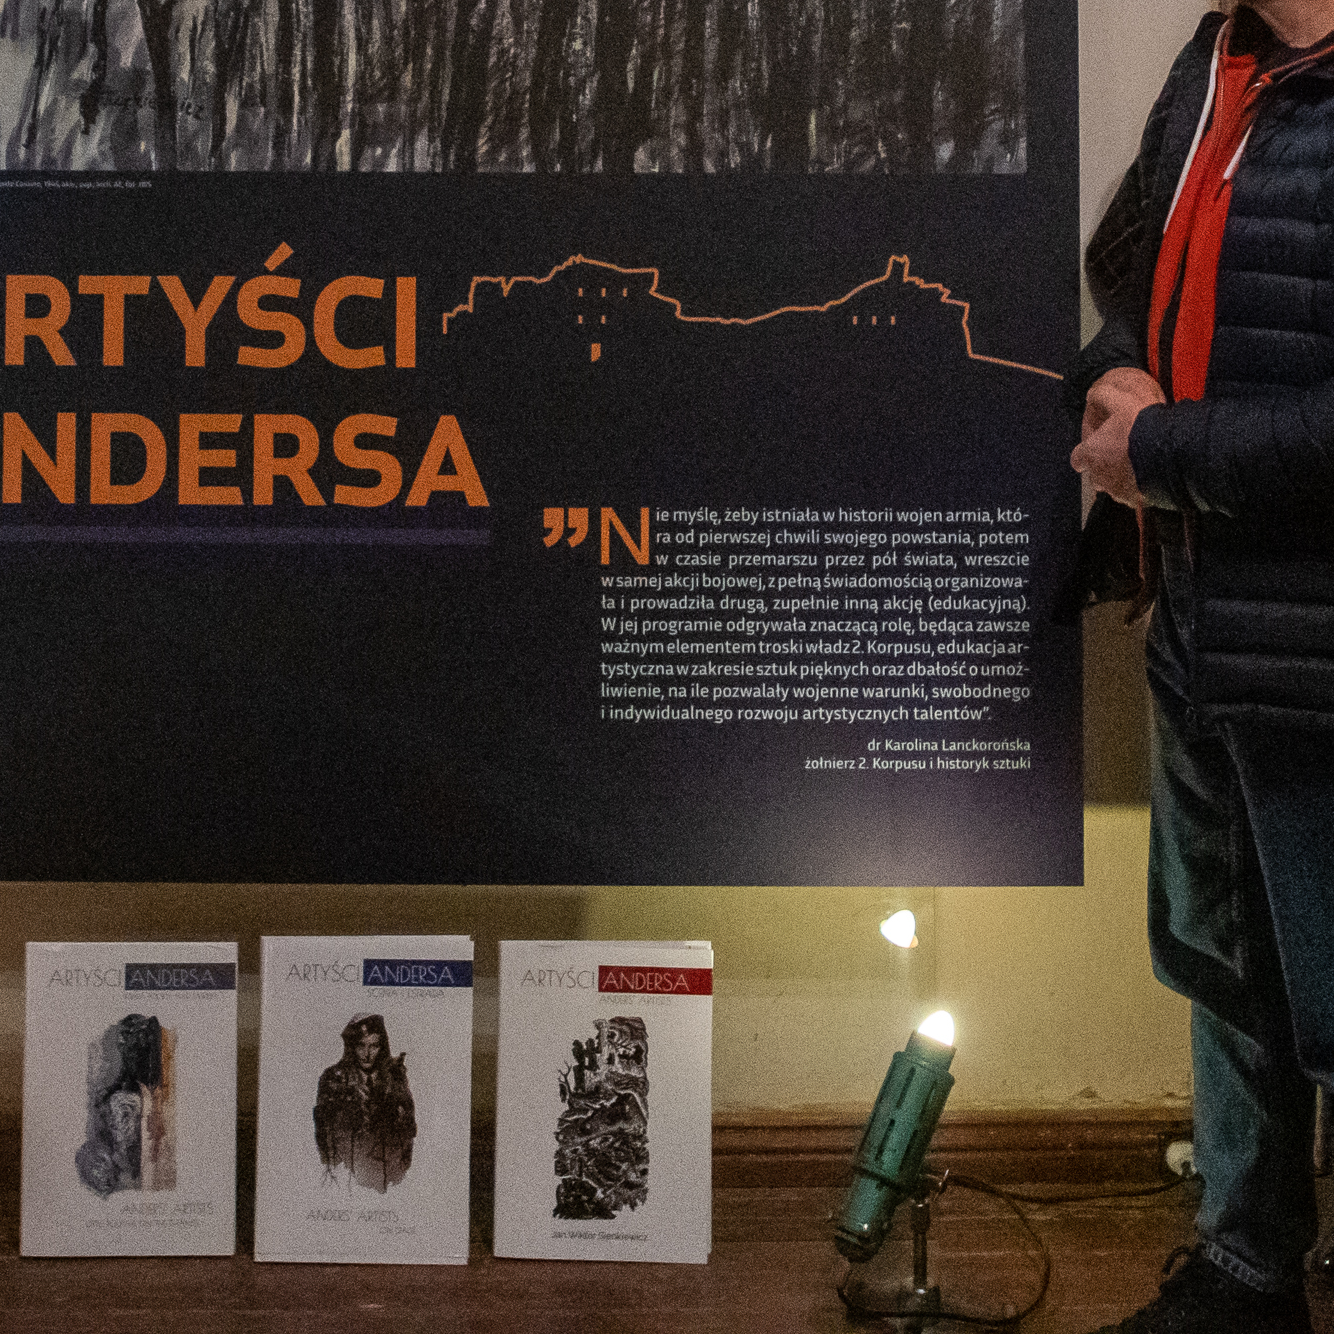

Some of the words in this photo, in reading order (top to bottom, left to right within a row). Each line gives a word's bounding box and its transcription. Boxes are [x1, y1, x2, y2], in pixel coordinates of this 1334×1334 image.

[672, 507, 722, 526] myślę,
[724, 507, 760, 526] żeby
[762, 507, 820, 522] istniała
[822, 511, 836, 522] w
[838, 507, 894, 522] historii
[896, 507, 943, 526] wojen
[945, 507, 994, 526] armia,
[996, 507, 1029, 522] któ-
[656, 533, 671, 544] ra
[674, 529, 695, 544] od
[699, 529, 771, 548] pierwszej
[774, 529, 820, 544] chwili
[823, 529, 888, 548] swojego
[891, 529, 975, 548] powstania,
[978, 529, 1030, 548] potem
[655, 555, 669, 566] w
[675, 551, 722, 566] czasie
[728, 555, 818, 570] przemarszu
[824, 555, 865, 570] przez
[872, 551, 898, 570] pół
[903, 551, 958, 570] świata,
[964, 551, 1030, 566] wreszcie
[600, 577, 614, 588] w
[616, 573, 662, 592] samej
[664, 573, 700, 592] akcji
[702, 573, 766, 592] bojowej,
[768, 577, 776, 588] z
[777, 573, 822, 592] pełną
[823, 573, 933, 592] świadomością
[934, 573, 1030, 592] organizowa-
[601, 595, 616, 610] ła
[620, 595, 625, 610] i
[630, 595, 715, 614] prowadziła
[719, 595, 768, 614] drugą,
[773, 595, 840, 614] zupełnie
[844, 595, 879, 614] inną
[882, 595, 924, 614] akcję
[927, 595, 1030, 614] (edukacyjną).
[601, 617, 617, 632] W
[619, 617, 638, 636] jej
[642, 617, 723, 636] programie
[726, 617, 807, 636] odgrywała
[809, 621, 879, 636] znaczącą
[881, 617, 916, 636] rolę,
[918, 617, 974, 636] będąca
[976, 621, 1030, 632] zawsze
[600, 639, 665, 658] ważnym
[666, 639, 757, 654] elementem
[758, 639, 804, 654] troski
[805, 639, 850, 654] władz
[852, 639, 865, 654] 2.
[867, 639, 936, 658] Korpusu,
[937, 639, 1006, 658] edukacja
[1007, 643, 1030, 654] ar-
[600, 661, 674, 680] tystyczna
[676, 665, 689, 676] w
[691, 661, 754, 676] zakresie
[756, 661, 798, 676] sztuk
[799, 661, 870, 680] pięknych
[871, 665, 905, 676] oraz
[906, 661, 967, 676] dbałość
[968, 665, 979, 676] o
[980, 661, 1030, 676] umoż-
[601, 683, 665, 702] liwienie,
[668, 687, 687, 698] na
[690, 683, 710, 698] ile
[712, 683, 790, 702] pozwalały
[792, 683, 859, 702] wojenne
[861, 683, 929, 702] warunki,
[931, 683, 1030, 702] swobodnego
[601, 705, 605, 720] i
[609, 705, 734, 724] indywidualnego
[737, 705, 799, 724] rozwoju
[802, 705, 910, 724] artystycznych
[867, 738, 881, 752] dr
[884, 738, 939, 752] Karolina
[941, 738, 1031, 752] Lanckorońska
[804, 756, 856, 770] żołnierz
[858, 756, 870, 770] 2.
[872, 756, 927, 773] Korpusu
[929, 756, 934, 770] i
[936, 756, 990, 773] historyk
[992, 756, 1031, 770] sztuki
[48, 965, 123, 988] ARTYŚCI
[129, 967, 216, 989] ANDERSA
[285, 960, 360, 983] ARTYŚCI
[367, 964, 455, 986] ANDERSA
[520, 966, 596, 989] ARTYŚCI
[602, 970, 691, 993] ANDERSA
